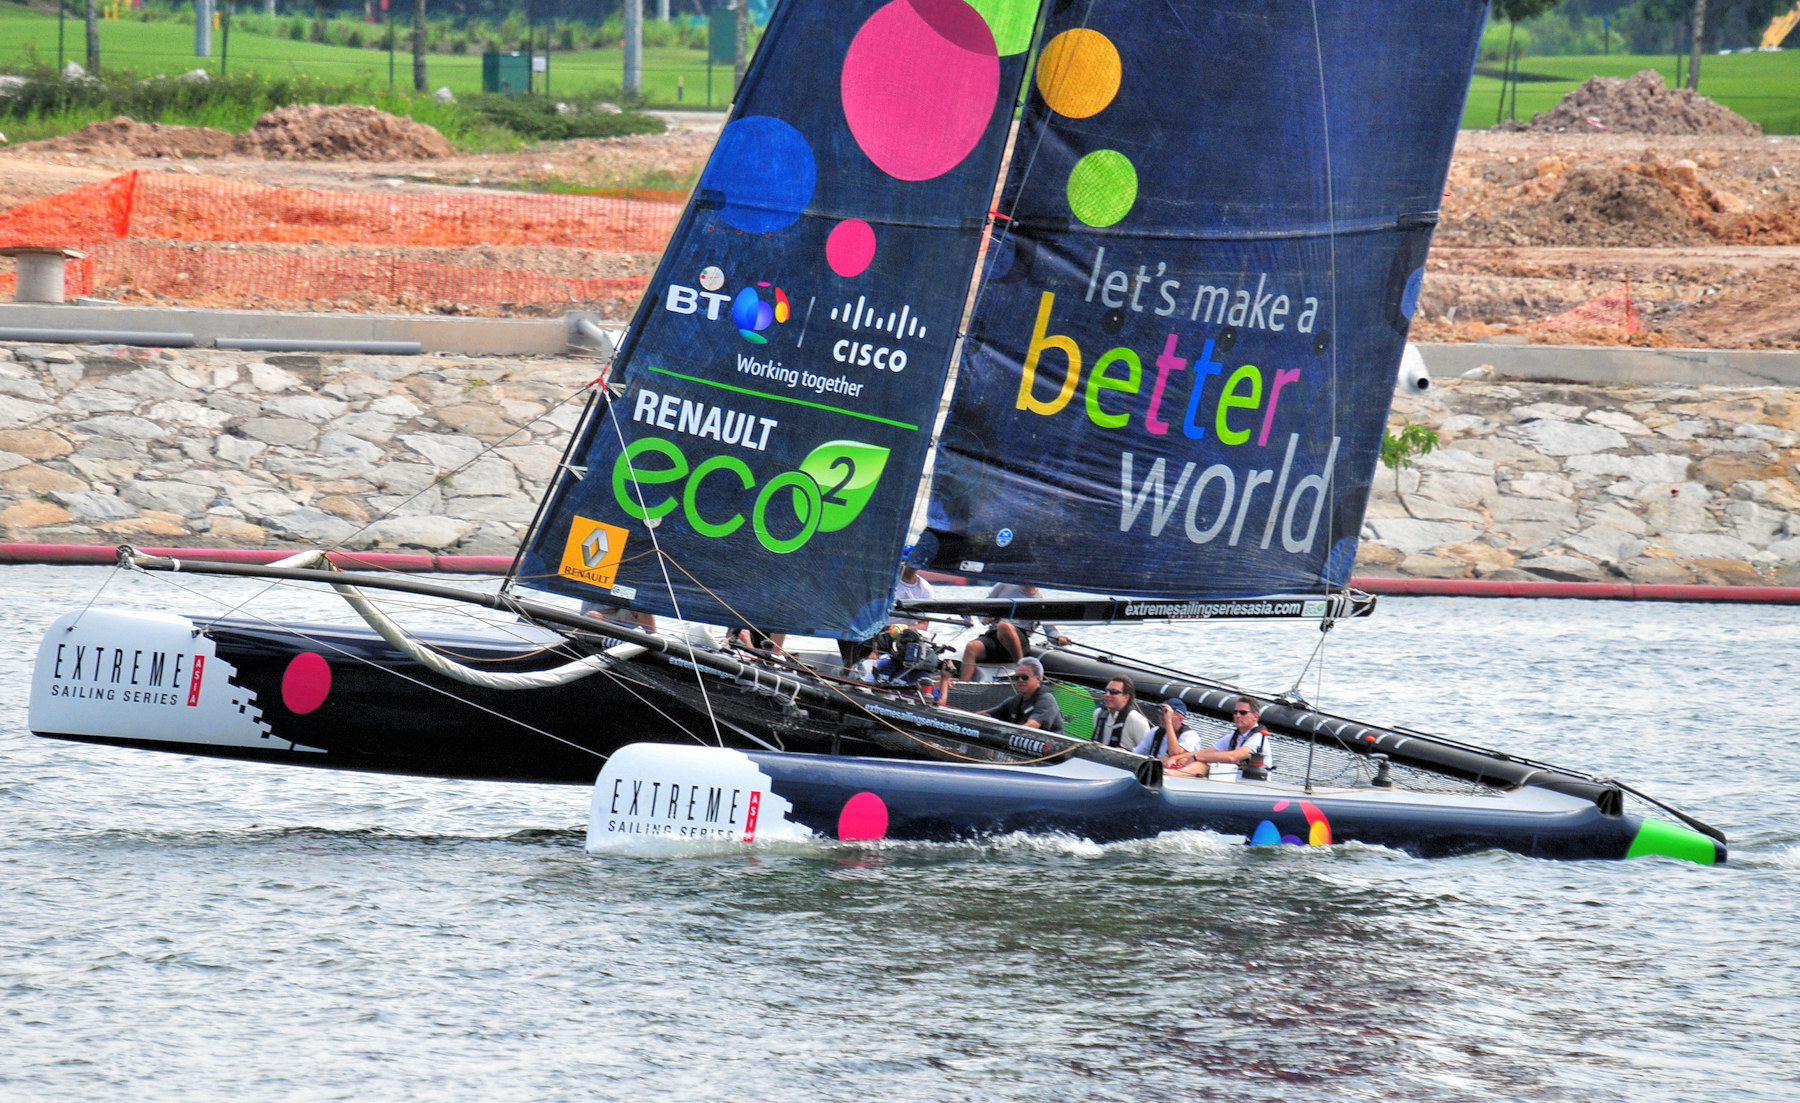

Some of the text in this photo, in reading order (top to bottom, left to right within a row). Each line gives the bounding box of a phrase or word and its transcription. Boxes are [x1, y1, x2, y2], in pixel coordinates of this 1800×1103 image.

[665, 284, 731, 321] BT
[1192, 273, 1290, 333] make
[1297, 296, 1319, 334] a
[736, 353, 864, 398] Working together
[832, 339, 907, 373] CISCO
[1015, 291, 1301, 447] better
[632, 389, 777, 451] RENAULT
[1119, 433, 1341, 554] world
[564, 565, 610, 584] RENAULT
[1125, 601, 1301, 618] extremesailingseriesasia.com
[54, 643, 184, 688] EXTREME
[189, 658, 203, 704] ASIA
[51, 685, 178, 706] SAILING SERIES
[864, 702, 980, 739] extremesailingseriesasia.com
[610, 778, 741, 825] EXTREME
